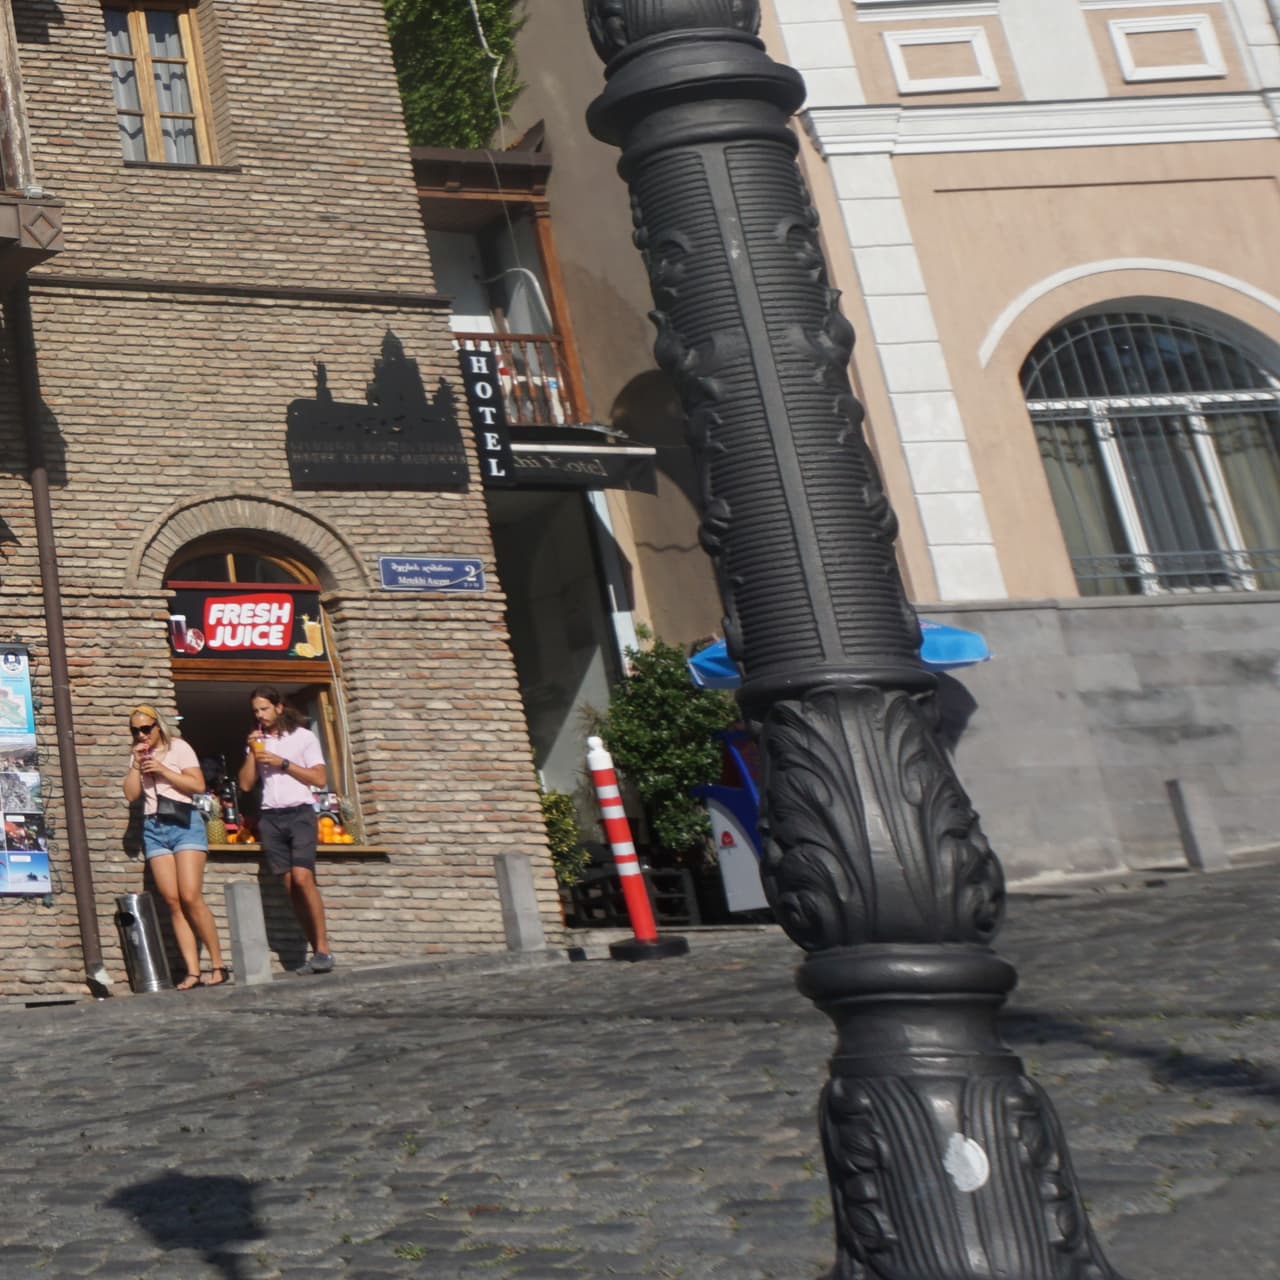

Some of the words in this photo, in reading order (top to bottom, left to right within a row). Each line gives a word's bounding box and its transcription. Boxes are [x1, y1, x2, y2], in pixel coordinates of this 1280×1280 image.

[469, 356, 506, 477] HOTEL
[464, 564, 477, 581] 2
[208, 602, 291, 625] FRESH
[208, 624, 285, 648] JUICE
